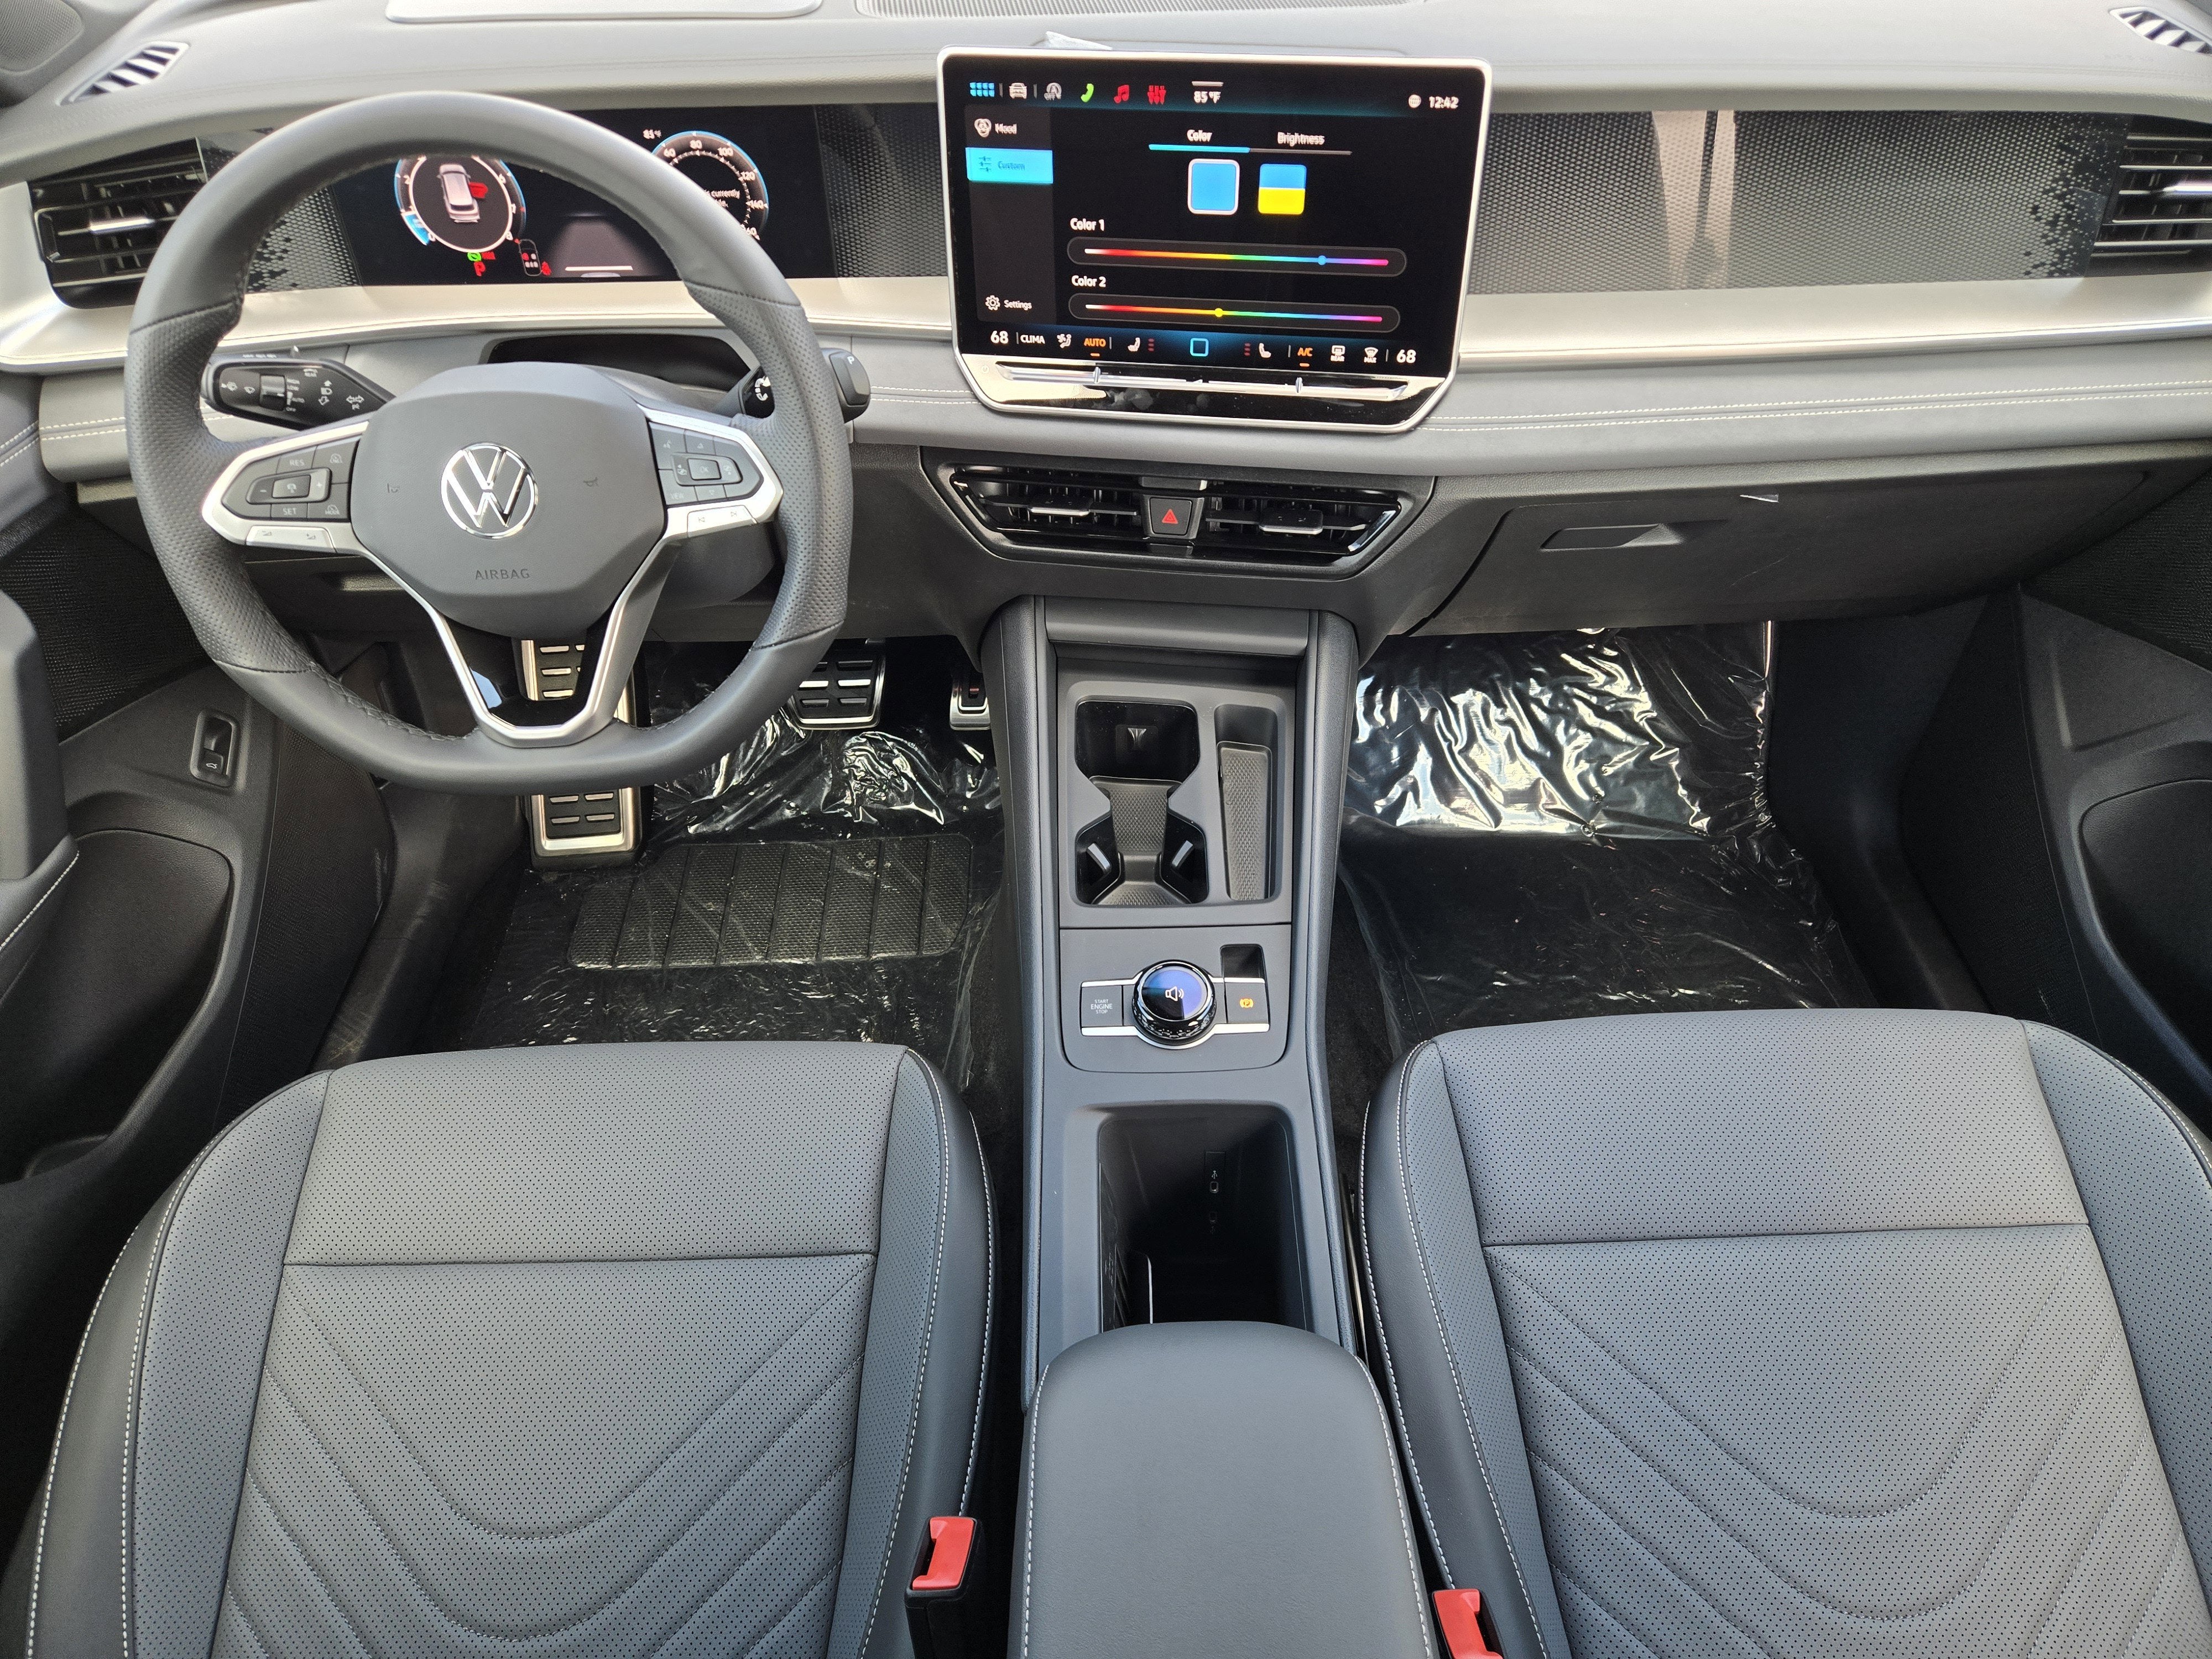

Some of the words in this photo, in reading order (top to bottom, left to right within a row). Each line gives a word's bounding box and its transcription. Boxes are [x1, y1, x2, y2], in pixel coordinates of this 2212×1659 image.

[1193, 91, 1208, 103] 85
[1429, 96, 1459, 108] 12:42
[995, 123, 1017, 134] Mood
[1187, 129, 1212, 142] Color
[1277, 132, 1325, 147] Brightness
[690, 140, 703, 149] 80
[664, 148, 676, 158] 60
[718, 147, 733, 156] 100
[998, 161, 1025, 170] Custom
[741, 171, 755, 181] 120
[1070, 217, 1097, 231] Color
[1098, 219, 1105, 231] 1
[1071, 275, 1097, 287] Color
[1098, 276, 1106, 288] 2
[1004, 299, 1032, 311] Settings
[990, 330, 1009, 345] 68
[1020, 335, 1045, 345] CLIMA
[1083, 338, 1106, 347] AUTO
[1297, 347, 1313, 357] A/C
[1396, 349, 1416, 363] 68
[847, 356, 855, 365] P
[475, 568, 530, 580] AIRBAG
